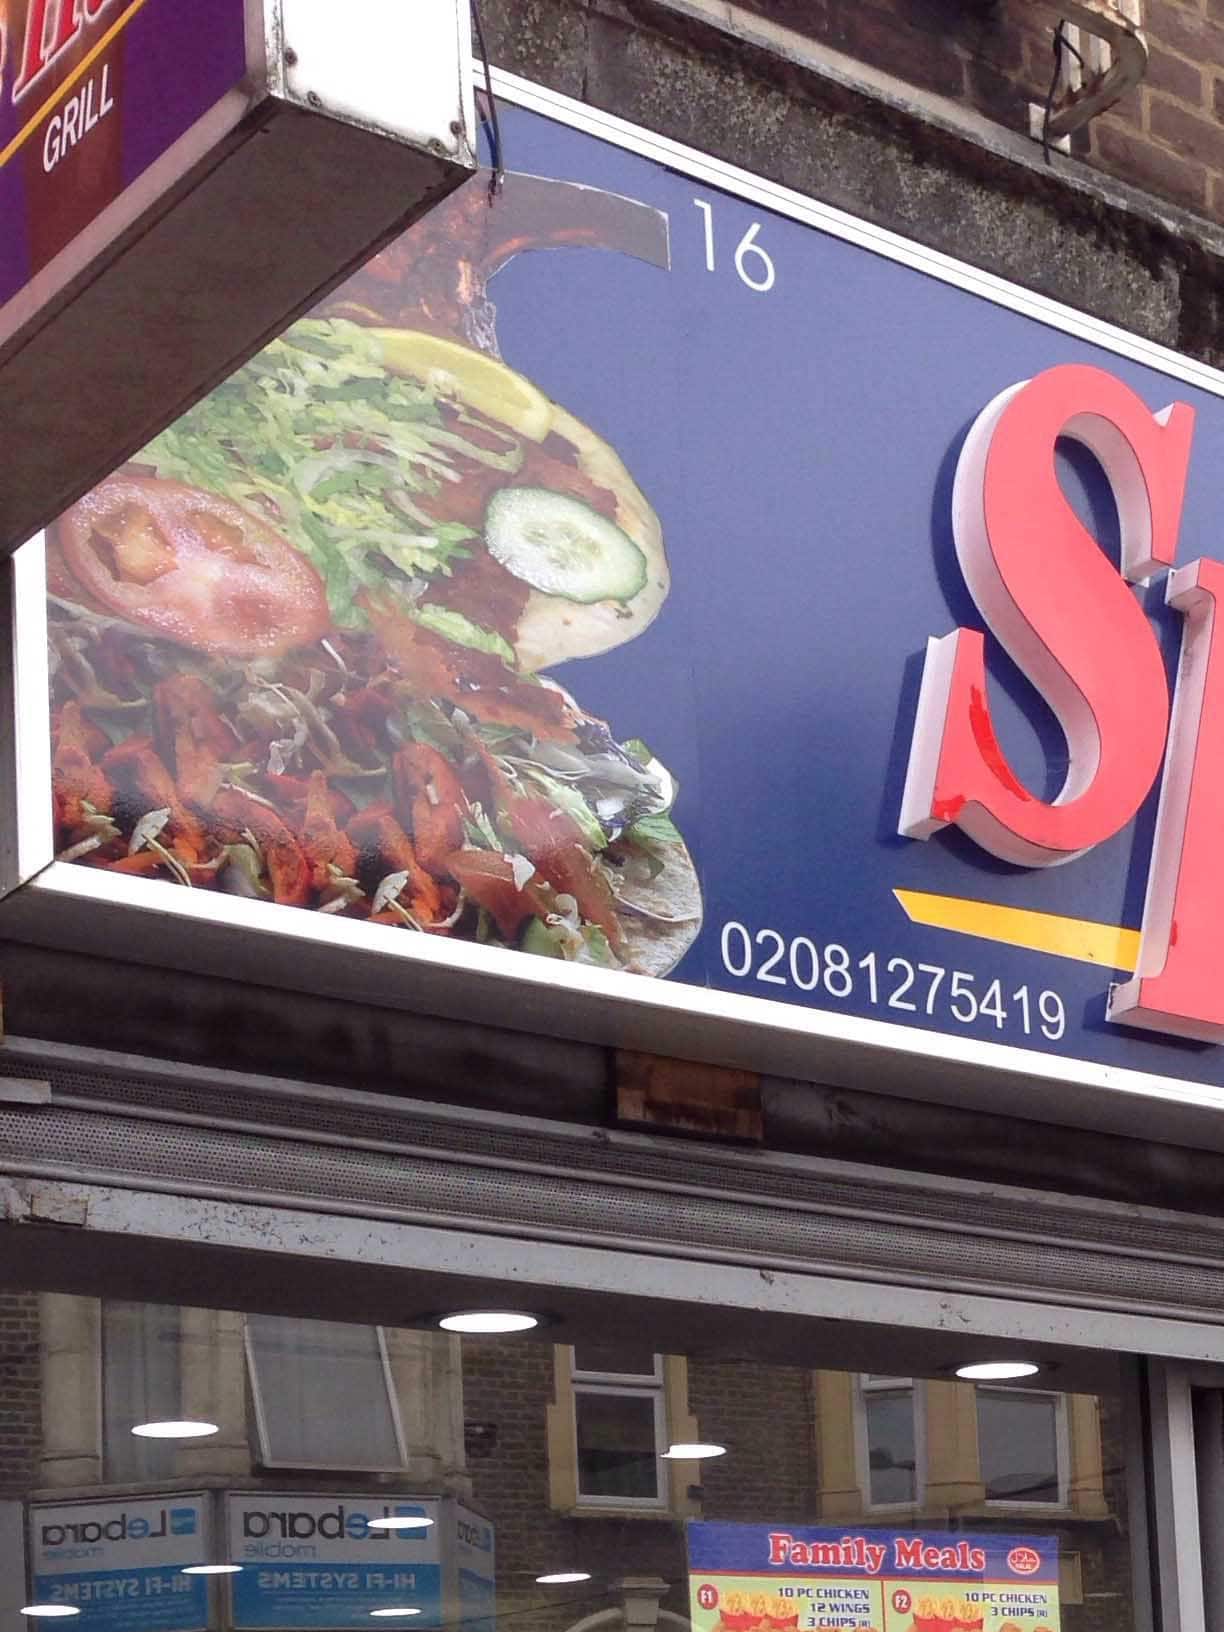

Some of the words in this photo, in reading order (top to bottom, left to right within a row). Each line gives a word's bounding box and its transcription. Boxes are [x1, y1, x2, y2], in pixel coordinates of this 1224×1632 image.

[43, 64, 113, 172] GRILL
[692, 199, 776, 292] 16
[720, 921, 1066, 1041] 02081275419
[768, 1533, 886, 1574] Family
[894, 1538, 986, 1571] Meals
[778, 1588, 794, 1599] 10
[798, 1588, 813, 1599] PC
[815, 1588, 869, 1600] CHICKEN
[965, 1593, 978, 1603] 10
[982, 1593, 996, 1603] PC
[1000, 1593, 1047, 1604] CHICKEN
[811, 1603, 825, 1613] 12
[829, 1603, 870, 1614] WINGS
[991, 1607, 998, 1616] 3
[1001, 1607, 1035, 1617] CHIPS
[808, 1617, 815, 1627] 3
[818, 1617, 856, 1628] CHIPS
